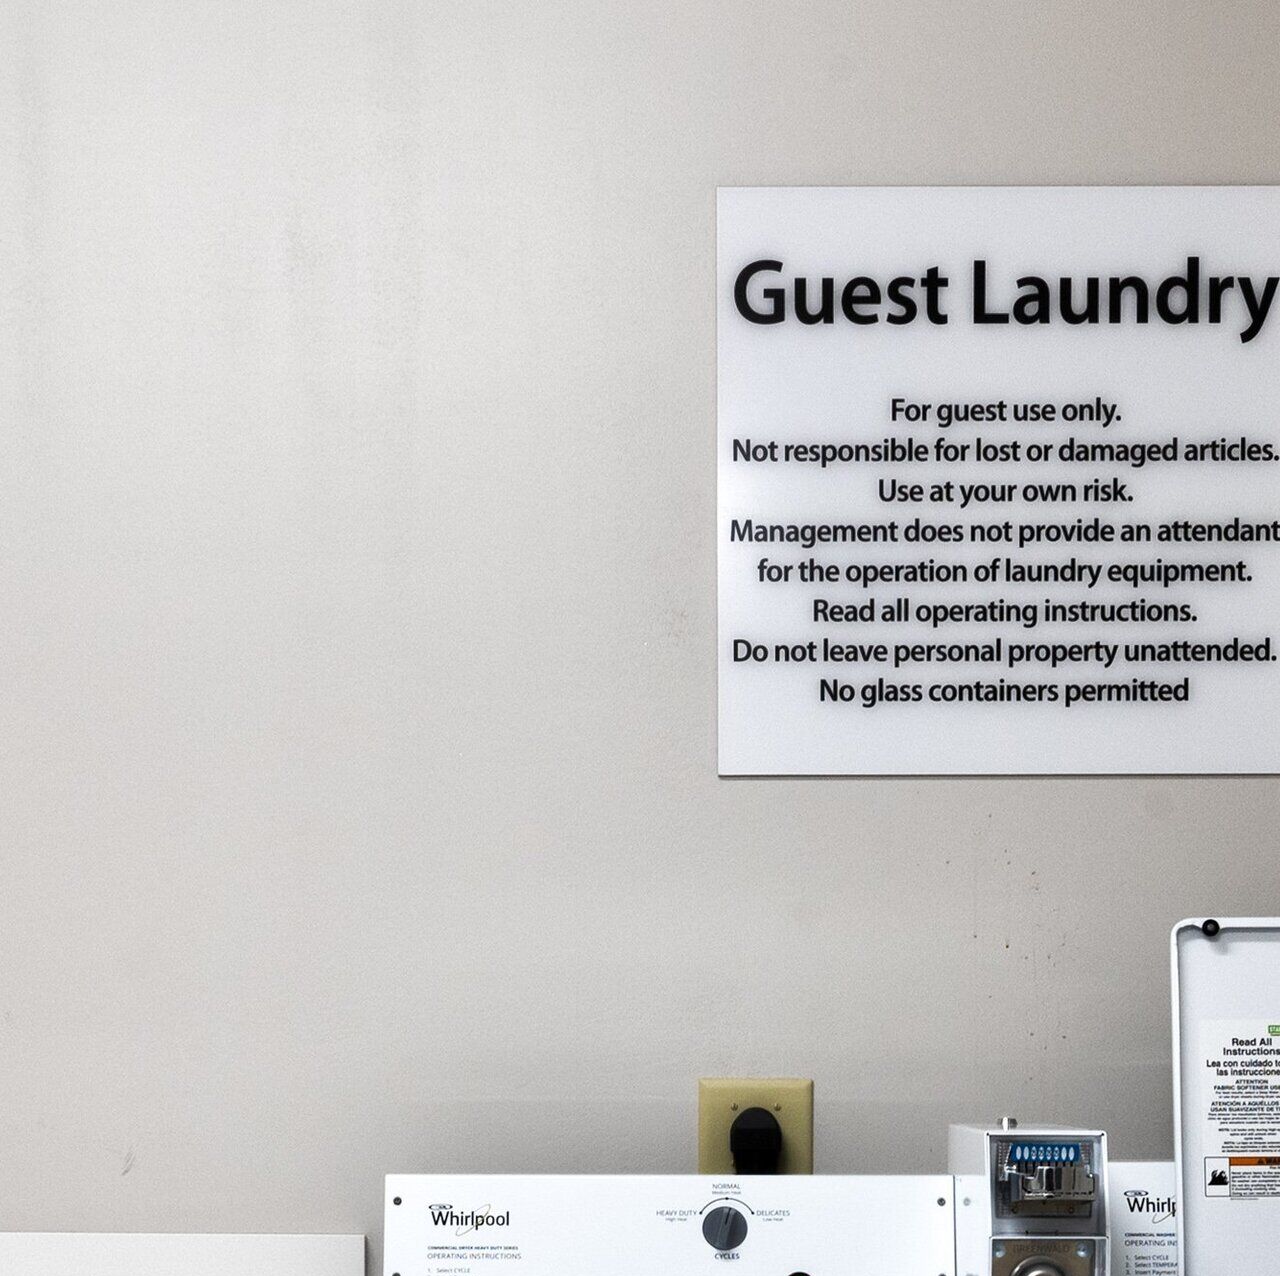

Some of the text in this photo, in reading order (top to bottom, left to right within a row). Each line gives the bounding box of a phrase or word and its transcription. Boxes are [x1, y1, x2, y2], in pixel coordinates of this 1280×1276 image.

[733, 256, 1280, 344] Guest Laundry
[891, 396, 1122, 429] For guest use only.
[732, 436, 1280, 469] Not responsible for lost or damaged articles.
[878, 477, 1134, 509] Use at your own risk.
[730, 519, 899, 549] Management
[903, 517, 965, 543] does
[970, 521, 1014, 543] not
[1018, 517, 1116, 549] provide
[1120, 524, 1152, 543] an
[757, 557, 1253, 589] for the operation of laundry equipment.
[813, 597, 1198, 629] Read all operating instructions.
[733, 636, 1277, 669] Do not leave personal property unattended.
[820, 677, 1190, 709] No glass containers permitted
[1223, 1047, 1280, 1056] Instructions
[1231, 1037, 1273, 1046] Read All
[1206, 1059, 1221, 1068] Lea
[1240, 1059, 1273, 1068] cuidado
[1216, 1068, 1229, 1076] las
[431, 1210, 510, 1231] Whirlpool
